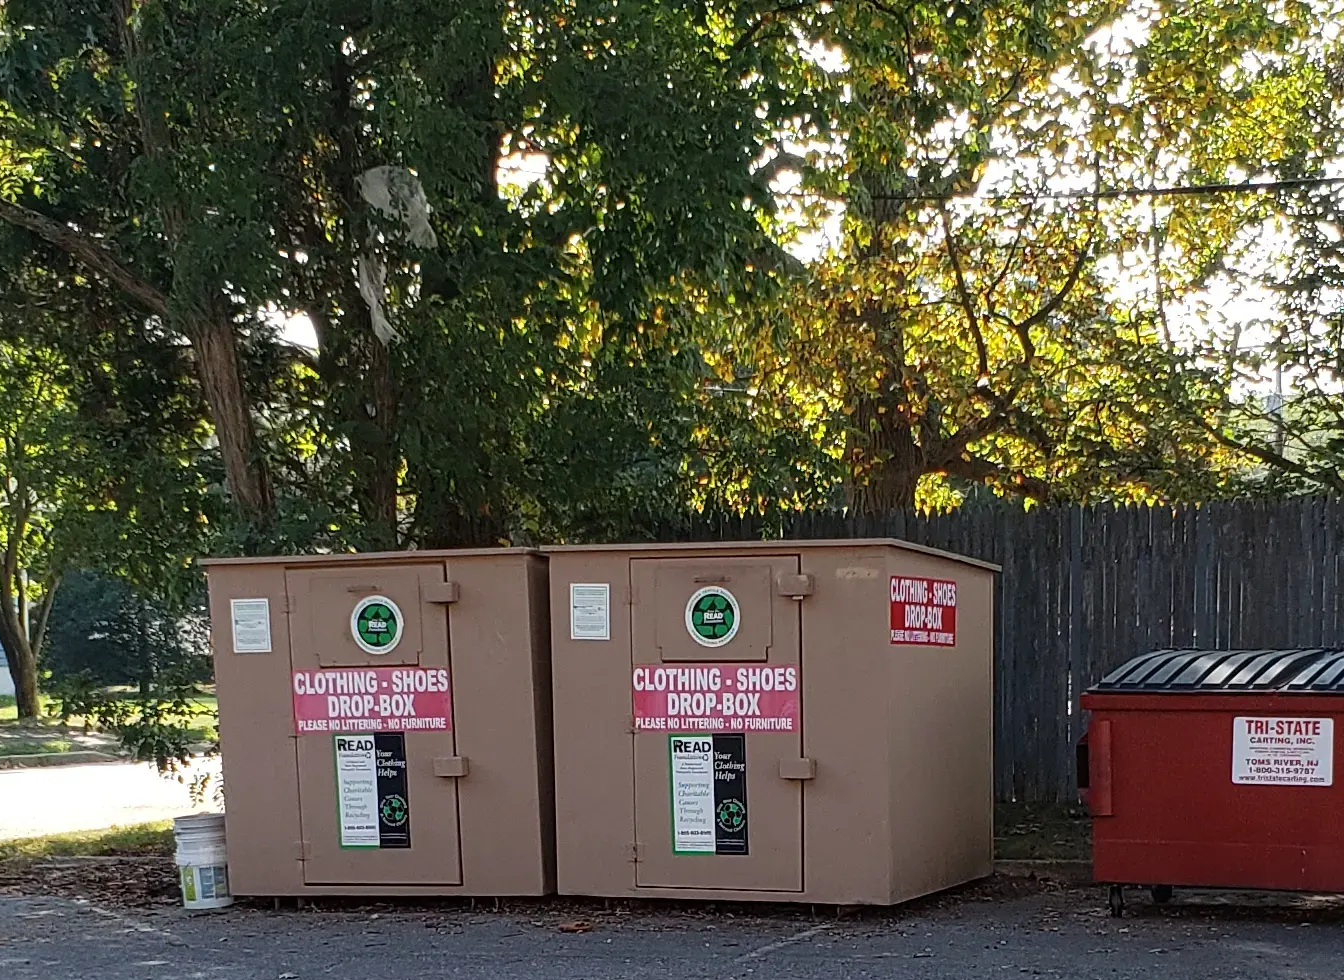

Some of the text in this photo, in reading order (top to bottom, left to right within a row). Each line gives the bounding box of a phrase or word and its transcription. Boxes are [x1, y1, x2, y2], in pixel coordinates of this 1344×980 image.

[891, 578, 928, 604] CLOTHING
[933, 581, 956, 607] SHOES
[905, 604, 943, 630] DROP-BOX
[294, 671, 378, 695] CLOTHING
[391, 669, 449, 693] SHOES
[632, 668, 722, 691] CLOTHING
[736, 667, 797, 691] SHOES
[327, 694, 416, 717] DROP-BOX
[666, 693, 761, 716] DROP-BOX
[298, 719, 327, 731] PLEASE
[329, 719, 340, 731] NO
[341, 718, 382, 730] LITTERING
[388, 718, 400, 730] NO
[401, 717, 446, 729] FURNITURE
[635, 718, 666, 729] PLEASE
[667, 718, 680, 729] NO
[681, 718, 724, 730] LITTERING
[730, 718, 743, 730] NO
[744, 718, 793, 730] FURNITURE
[1245, 720, 1321, 736] TRI-STATE
[337, 738, 374, 752] READ
[673, 739, 711, 753] READ
[1249, 737, 1315, 745] CARTING, INC.
[376, 749, 393, 758] Your
[714, 752, 732, 760] Your
[376, 758, 406, 769] Clothing
[714, 760, 745, 772] Clothing
[1245, 758, 1319, 767] TOMS RIVER, NJ
[377, 768, 398, 779] Helps
[715, 770, 736, 783] Helps
